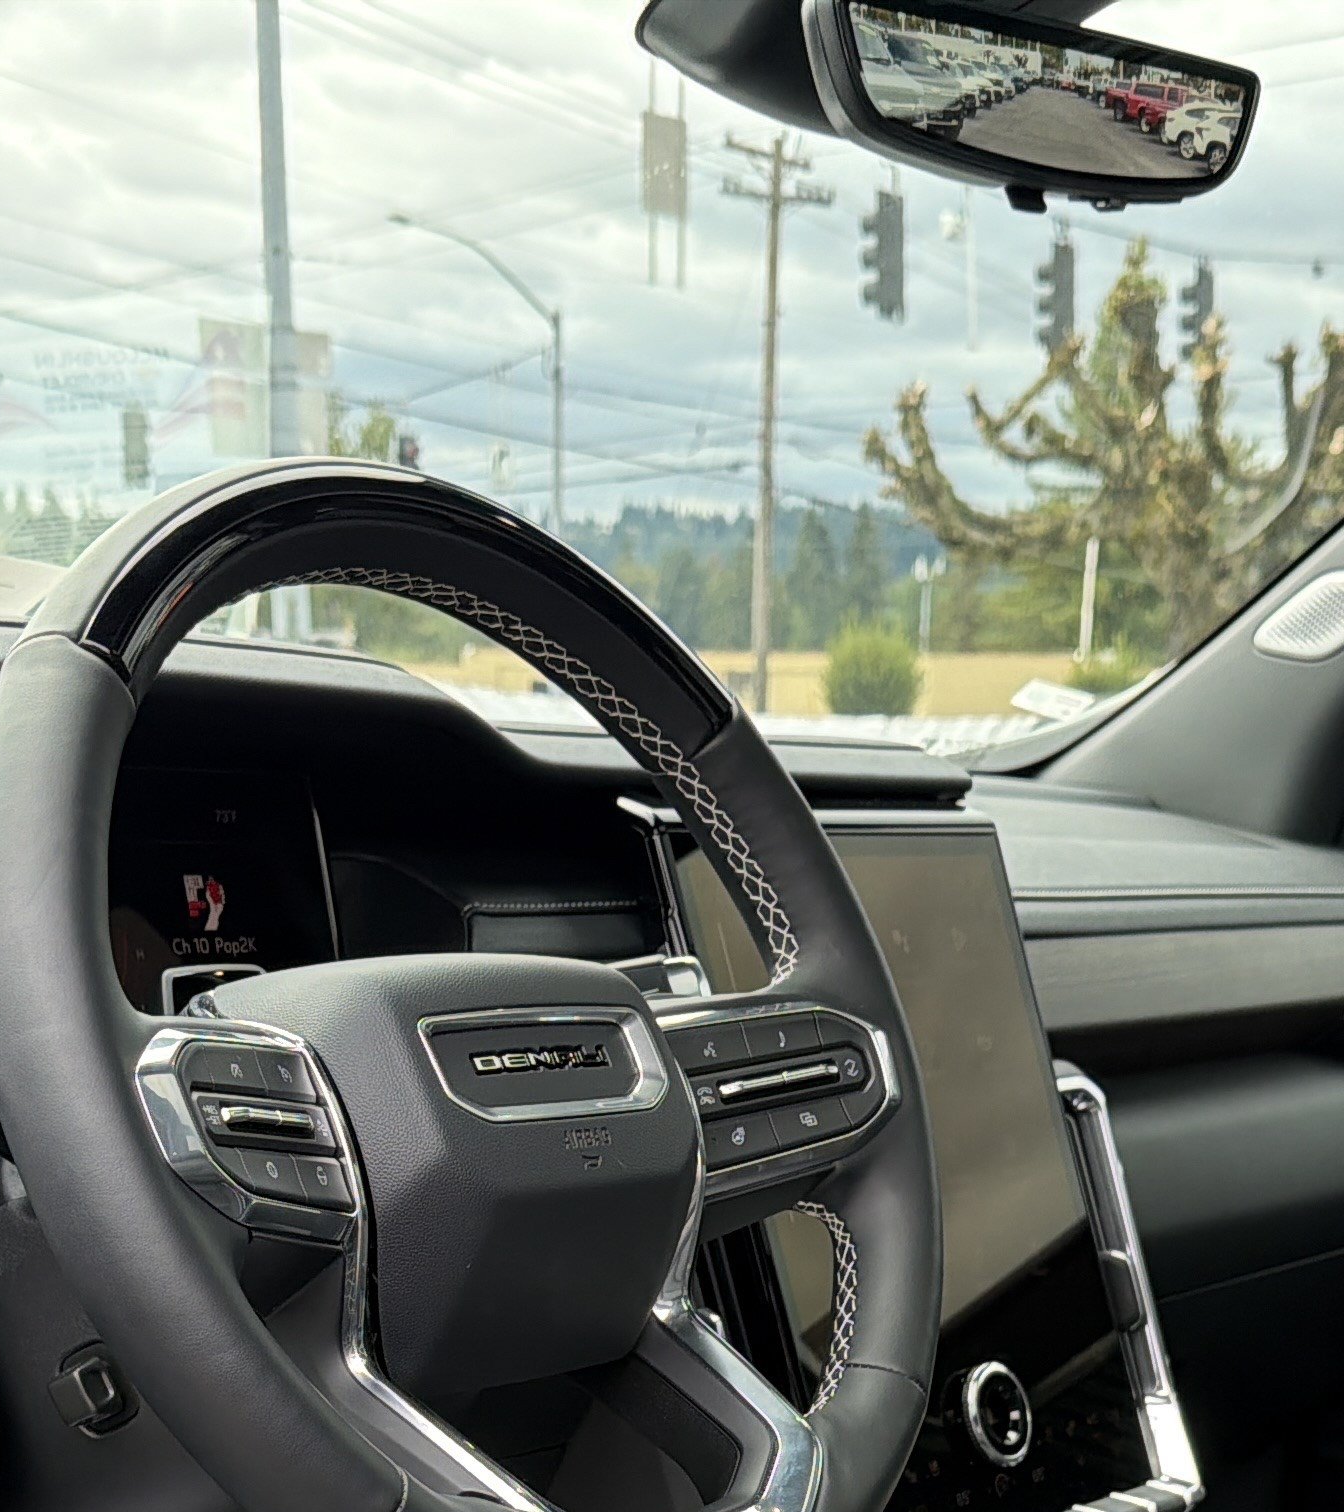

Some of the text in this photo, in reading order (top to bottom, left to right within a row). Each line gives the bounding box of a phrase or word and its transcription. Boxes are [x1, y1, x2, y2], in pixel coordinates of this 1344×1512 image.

[172, 936, 258, 957] Ch 10 Pop2K
[471, 1044, 613, 1073] DENALI
[564, 1128, 612, 1150] AIRBAG
